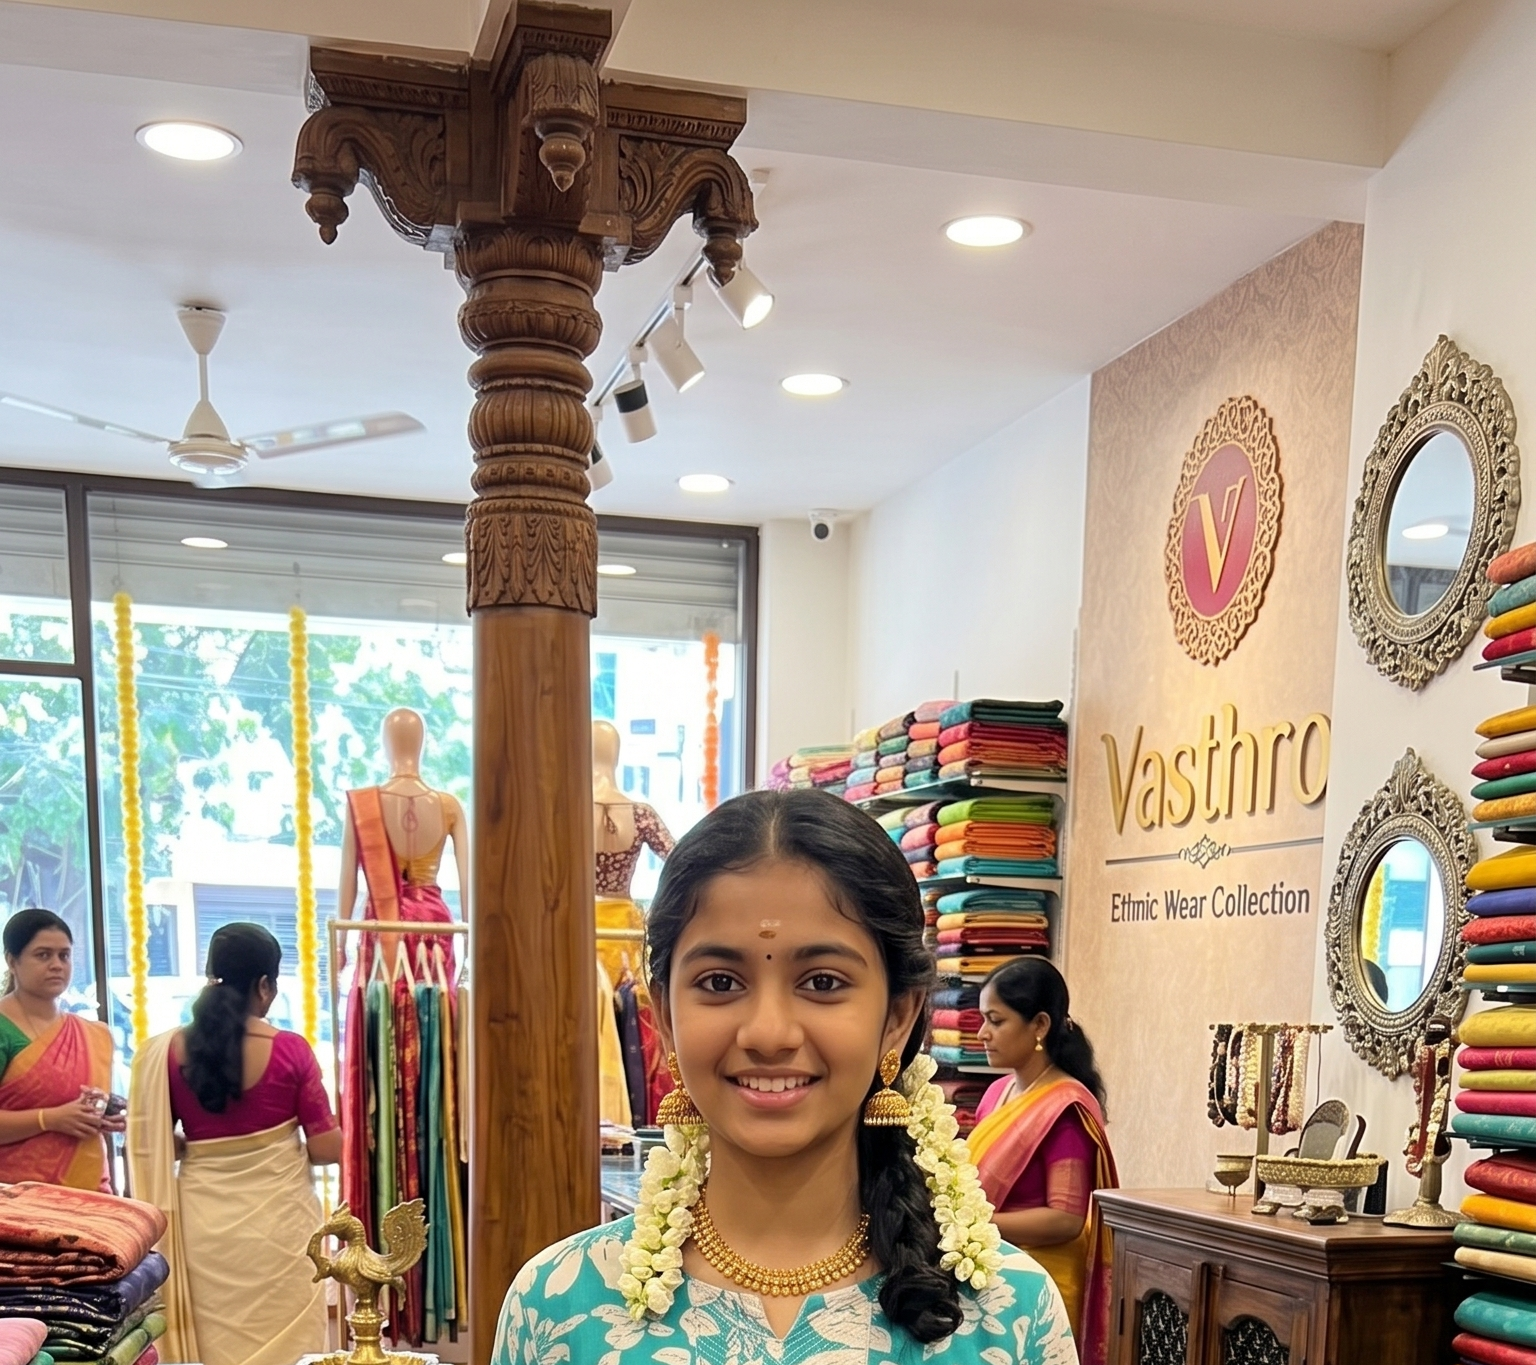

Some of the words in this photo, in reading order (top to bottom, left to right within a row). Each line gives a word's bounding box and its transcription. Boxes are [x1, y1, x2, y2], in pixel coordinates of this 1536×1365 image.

[1190, 474, 1247, 594] V
[1101, 703, 1332, 836] Vasthro
[1164, 889, 1207, 920] Wear
[1212, 881, 1310, 918] Collection
